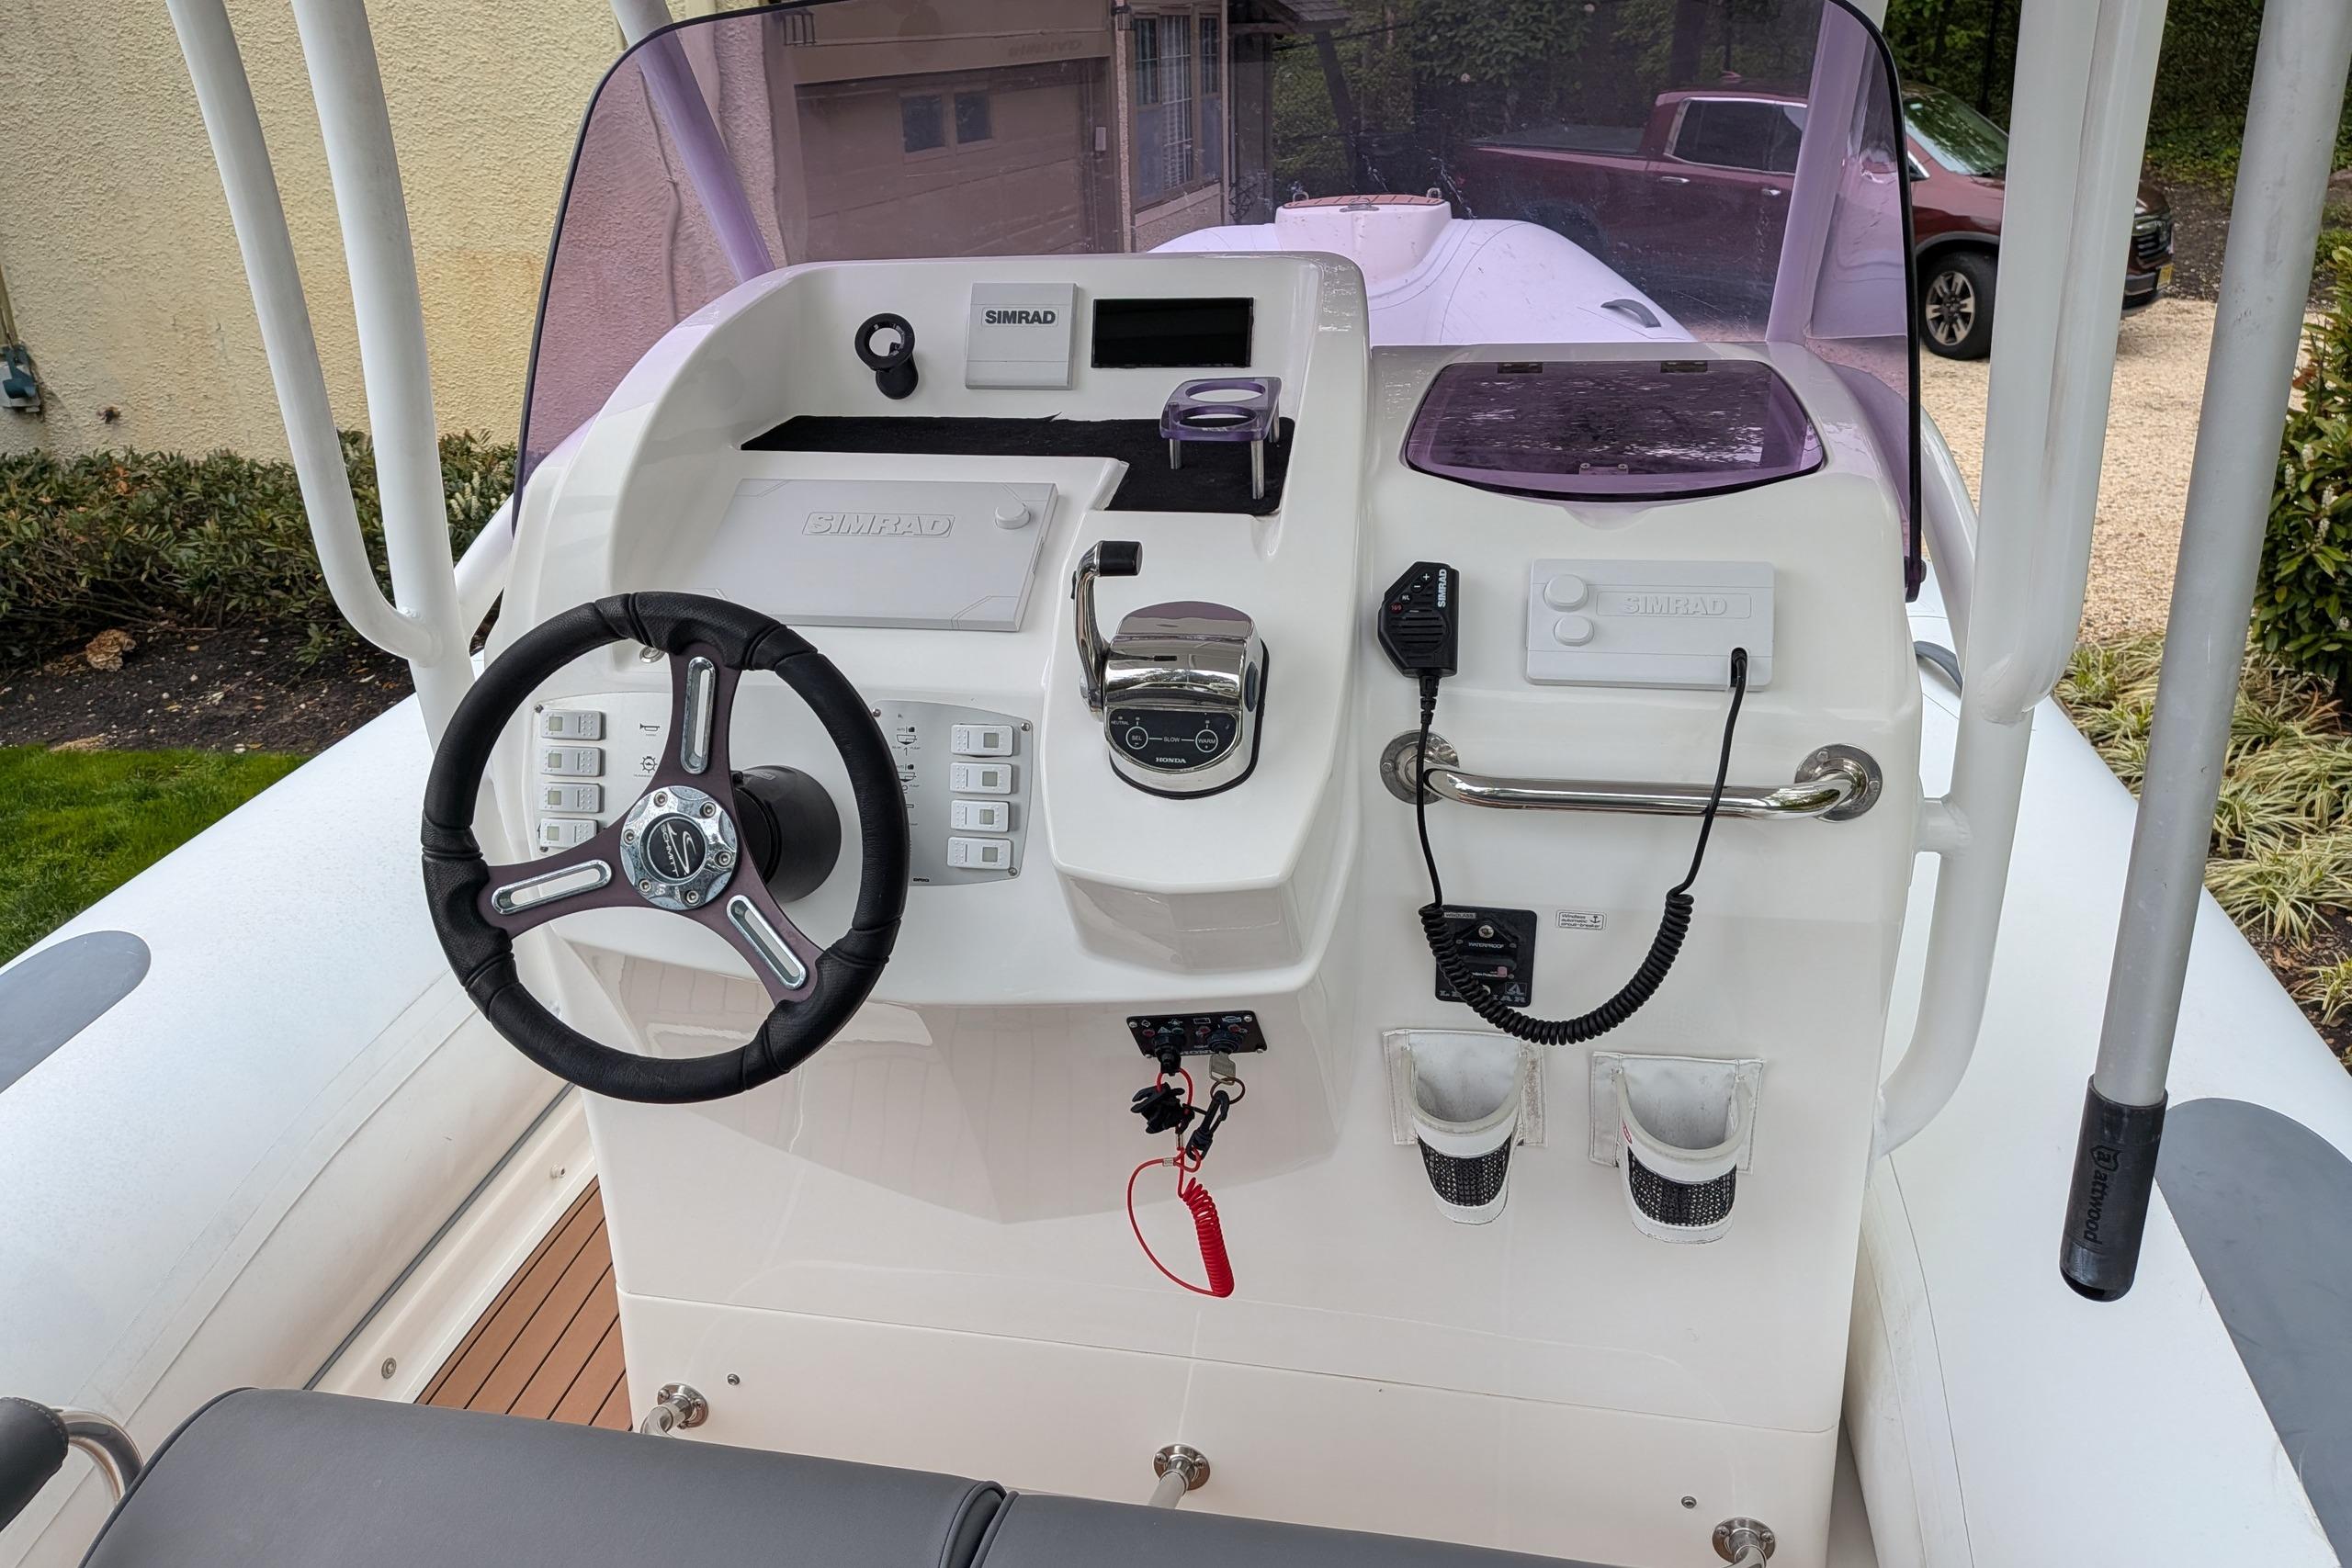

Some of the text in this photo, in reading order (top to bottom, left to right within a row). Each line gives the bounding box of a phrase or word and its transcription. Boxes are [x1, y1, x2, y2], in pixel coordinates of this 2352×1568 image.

[984, 310, 1057, 325] SIMRAD
[808, 513, 952, 536] SIMRAD
[1437, 568, 1449, 608] SIMRAD
[1623, 594, 1727, 616] SIMRAD
[1155, 756, 1187, 764] HONDA
[660, 824, 680, 877] SCHMITT
[2083, 1169, 2109, 1245] attwood
